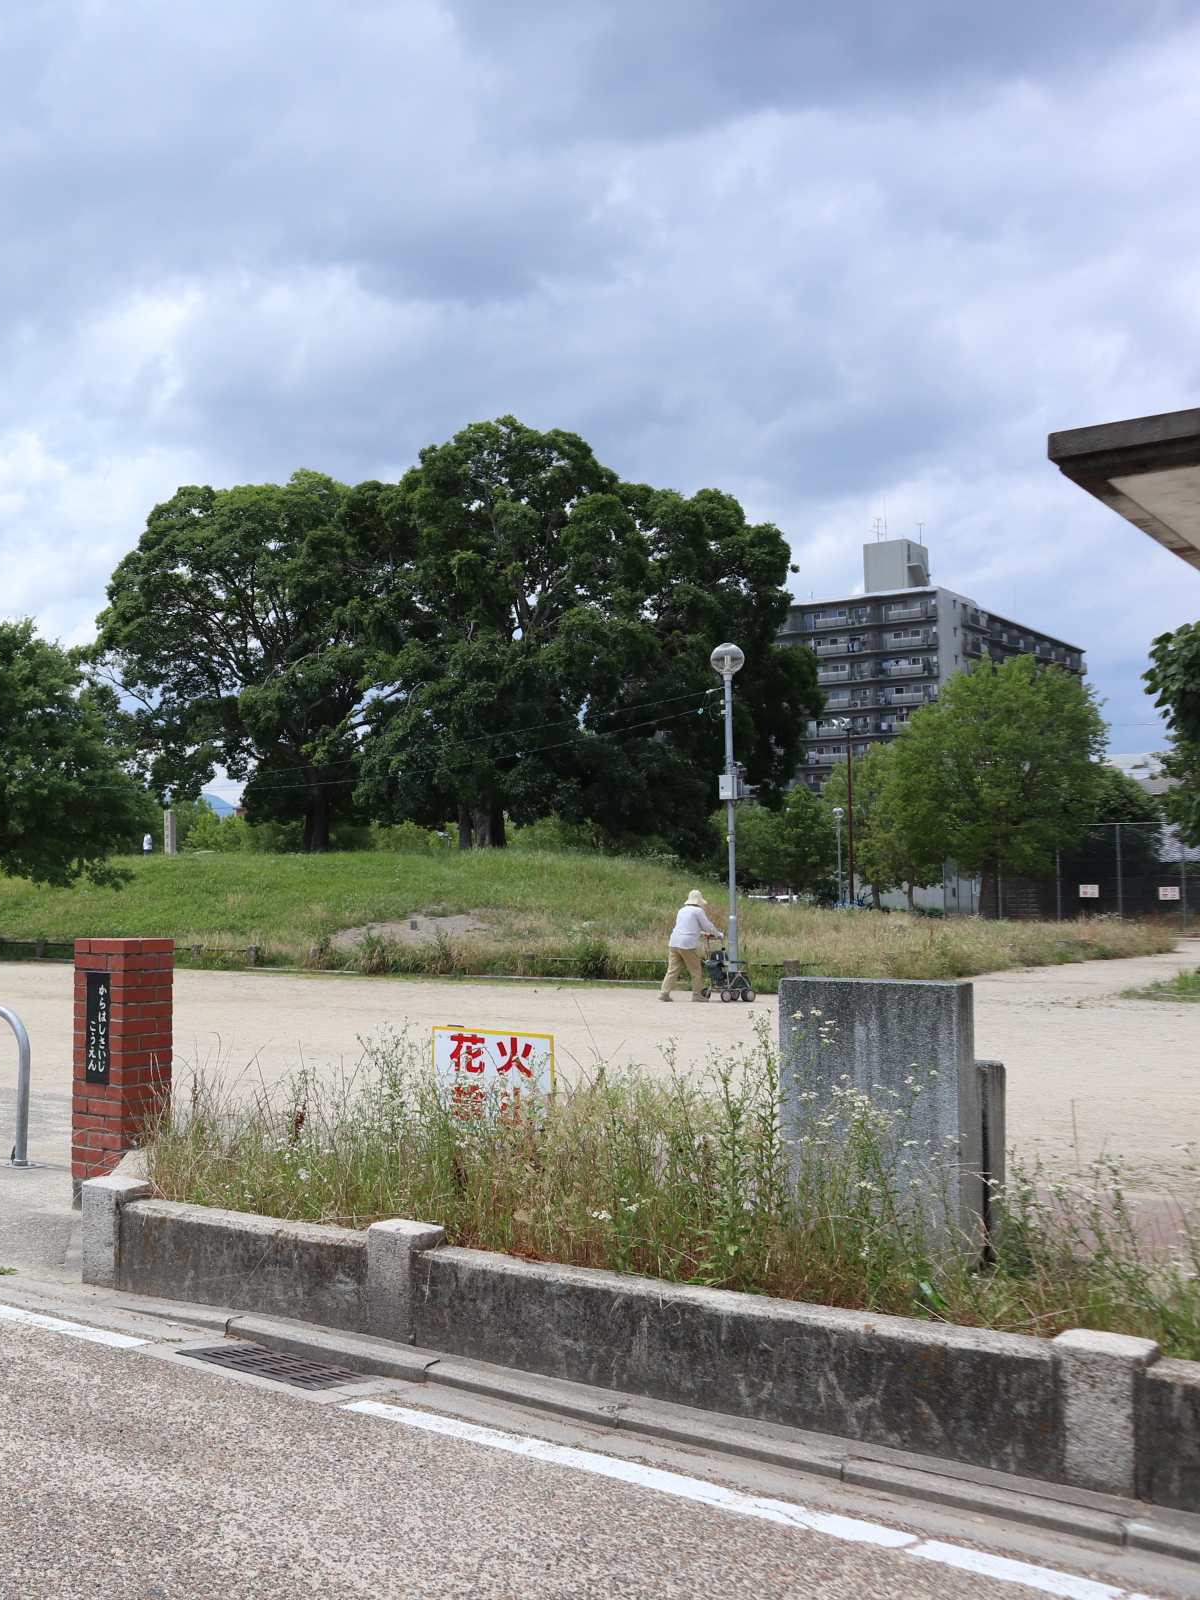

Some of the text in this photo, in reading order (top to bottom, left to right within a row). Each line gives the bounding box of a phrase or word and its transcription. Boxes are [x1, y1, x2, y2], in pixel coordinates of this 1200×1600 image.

[88, 1021, 97, 1071] こうえん
[98, 984, 107, 1072] からはしさいじ
[449, 1033, 533, 1078] 花火
